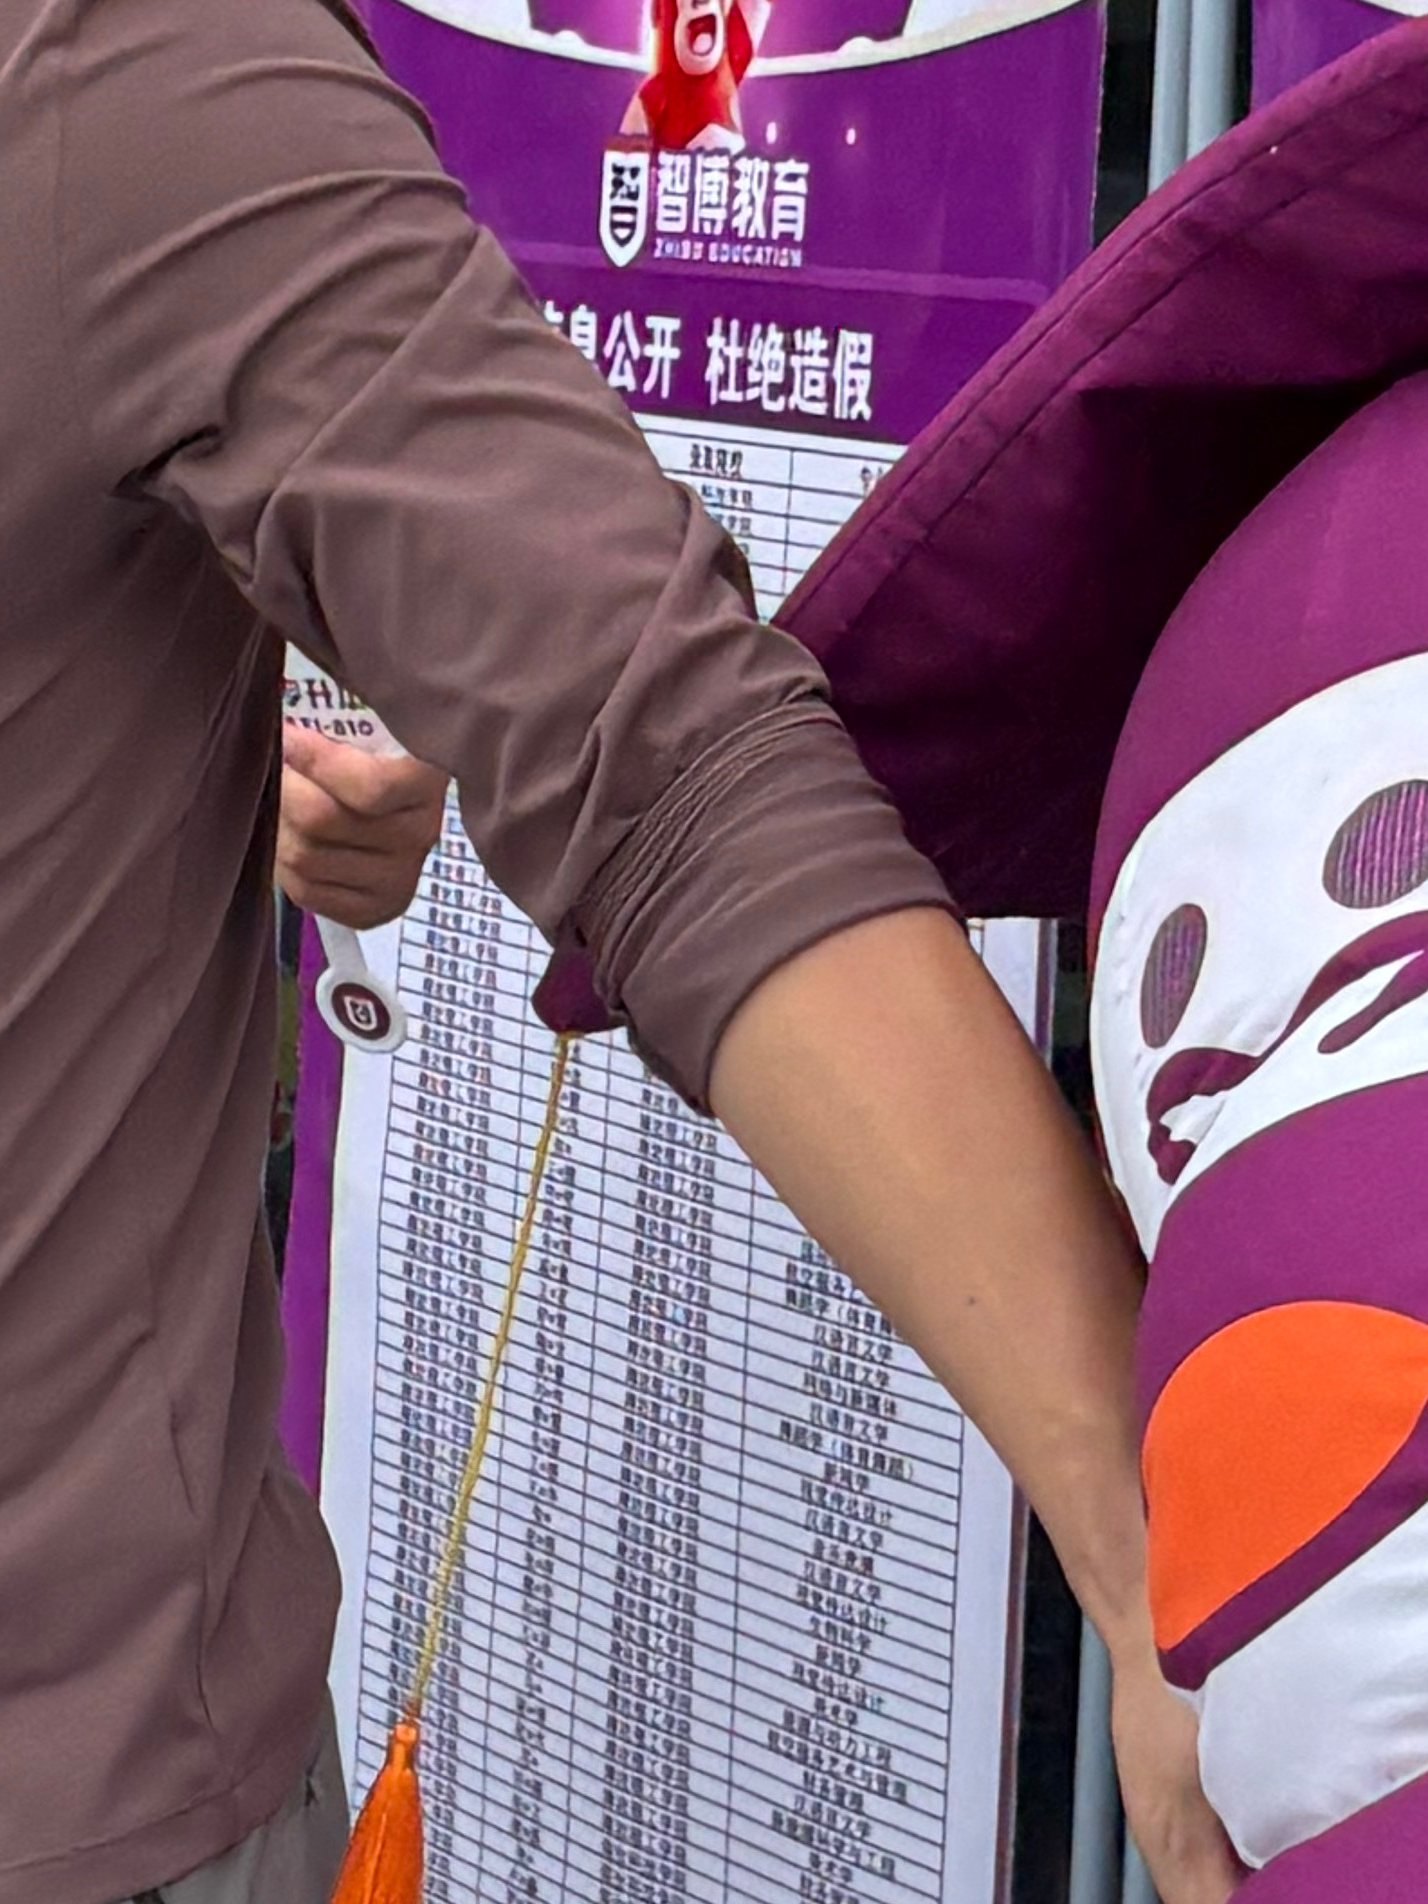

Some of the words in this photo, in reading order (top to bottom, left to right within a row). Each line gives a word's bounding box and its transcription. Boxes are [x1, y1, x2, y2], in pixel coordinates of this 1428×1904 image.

[655, 151, 810, 242] 智博教育
[708, 241, 803, 268] EDUCATION
[705, 317, 874, 421] 杜绝造假
